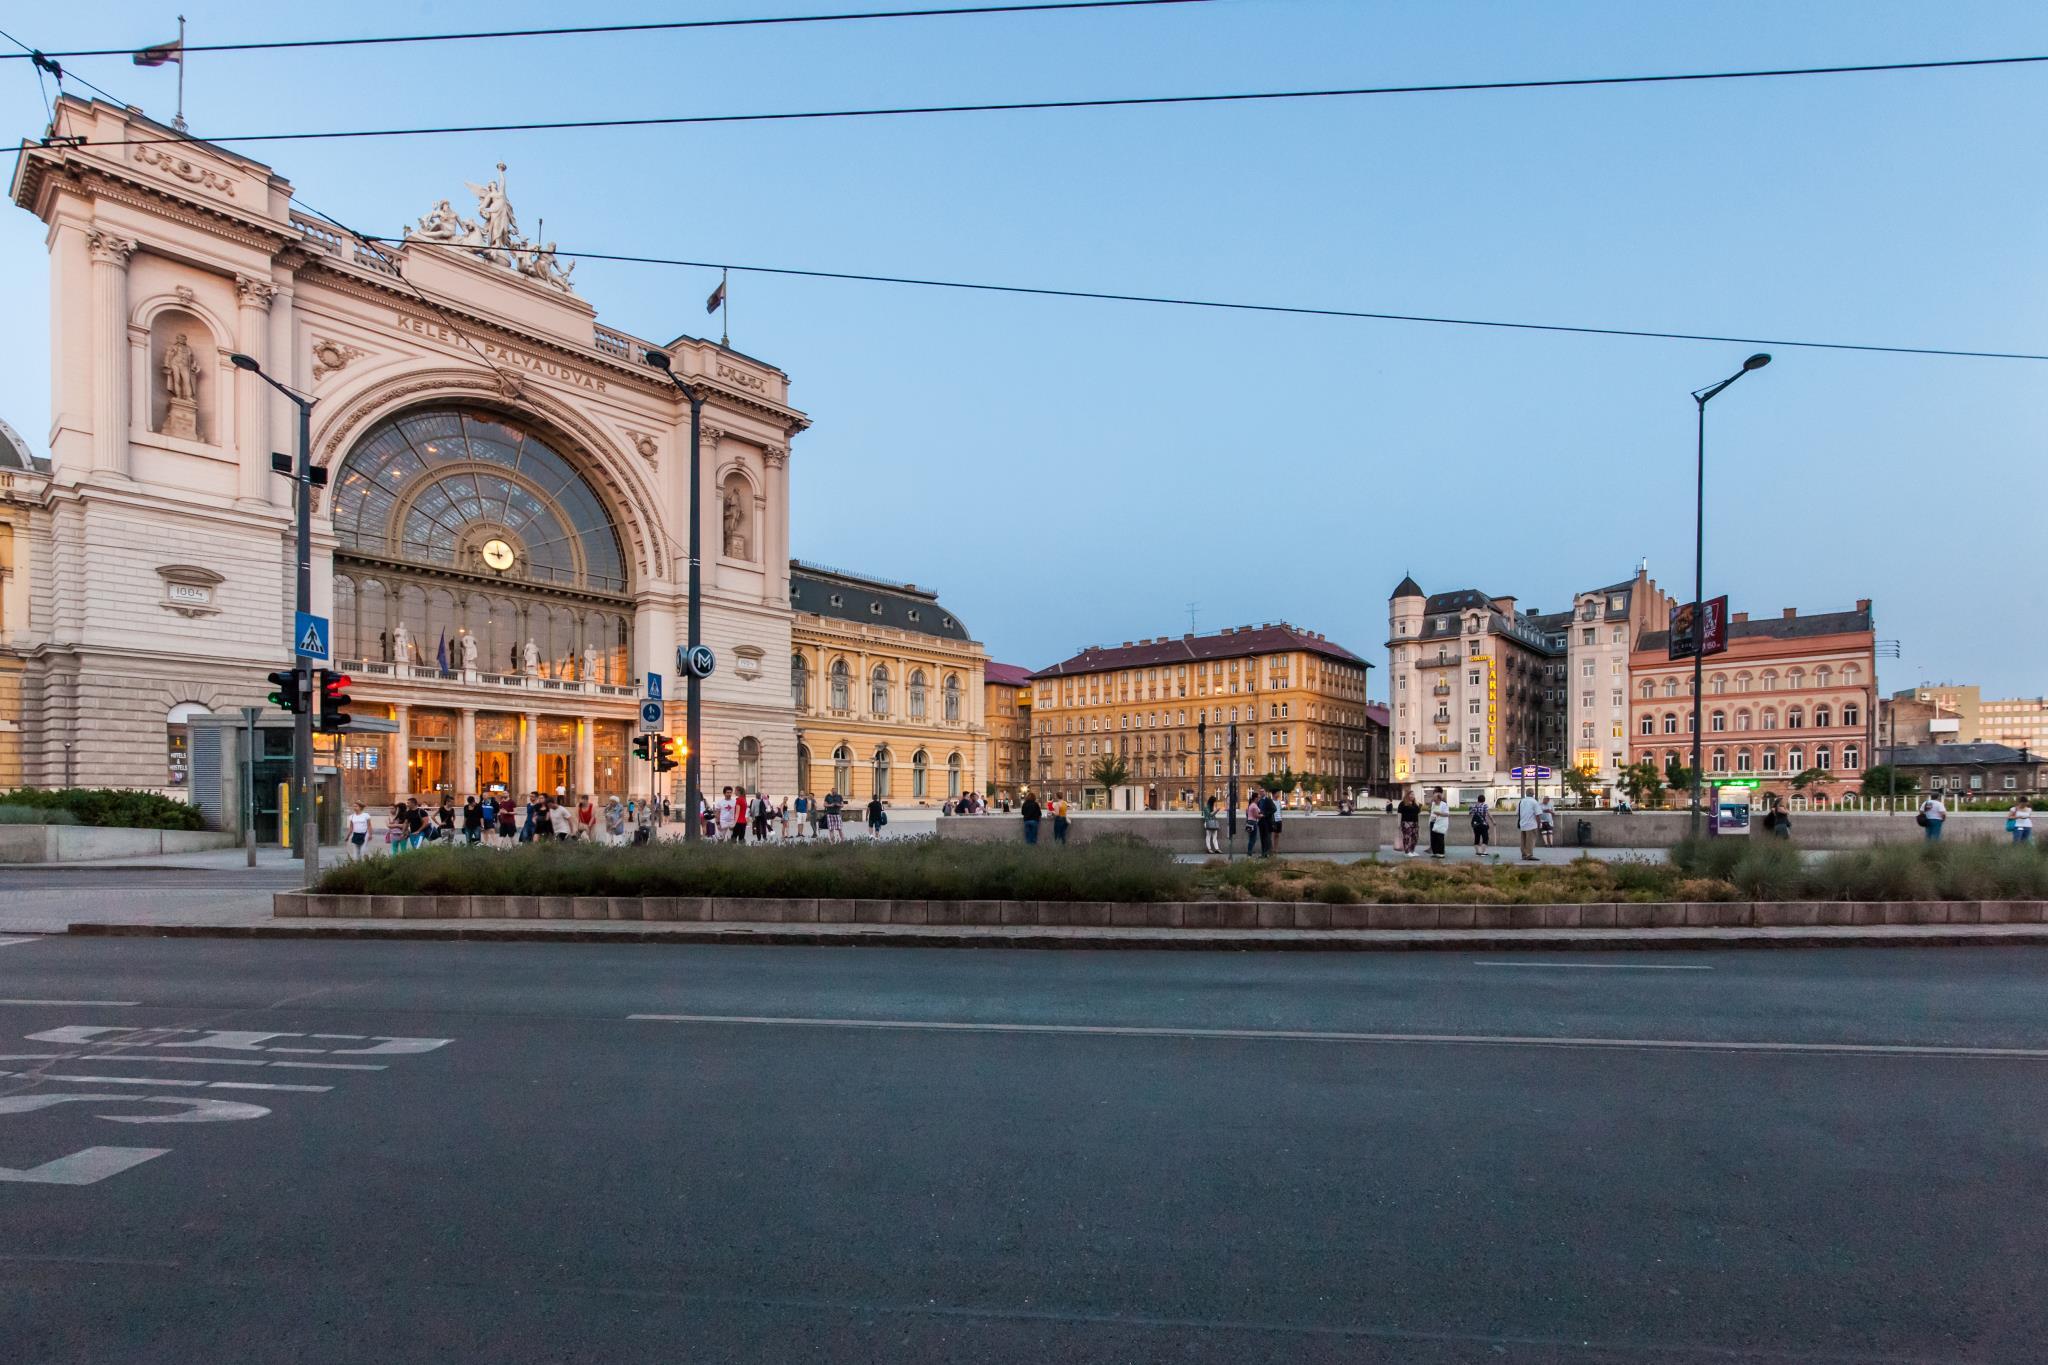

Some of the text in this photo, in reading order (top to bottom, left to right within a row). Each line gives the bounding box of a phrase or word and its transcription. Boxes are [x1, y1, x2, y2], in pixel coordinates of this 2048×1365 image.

[398, 314, 471, 349] KELETI
[697, 652, 711, 669] M
[1488, 660, 1497, 755] PARK HOTEL
